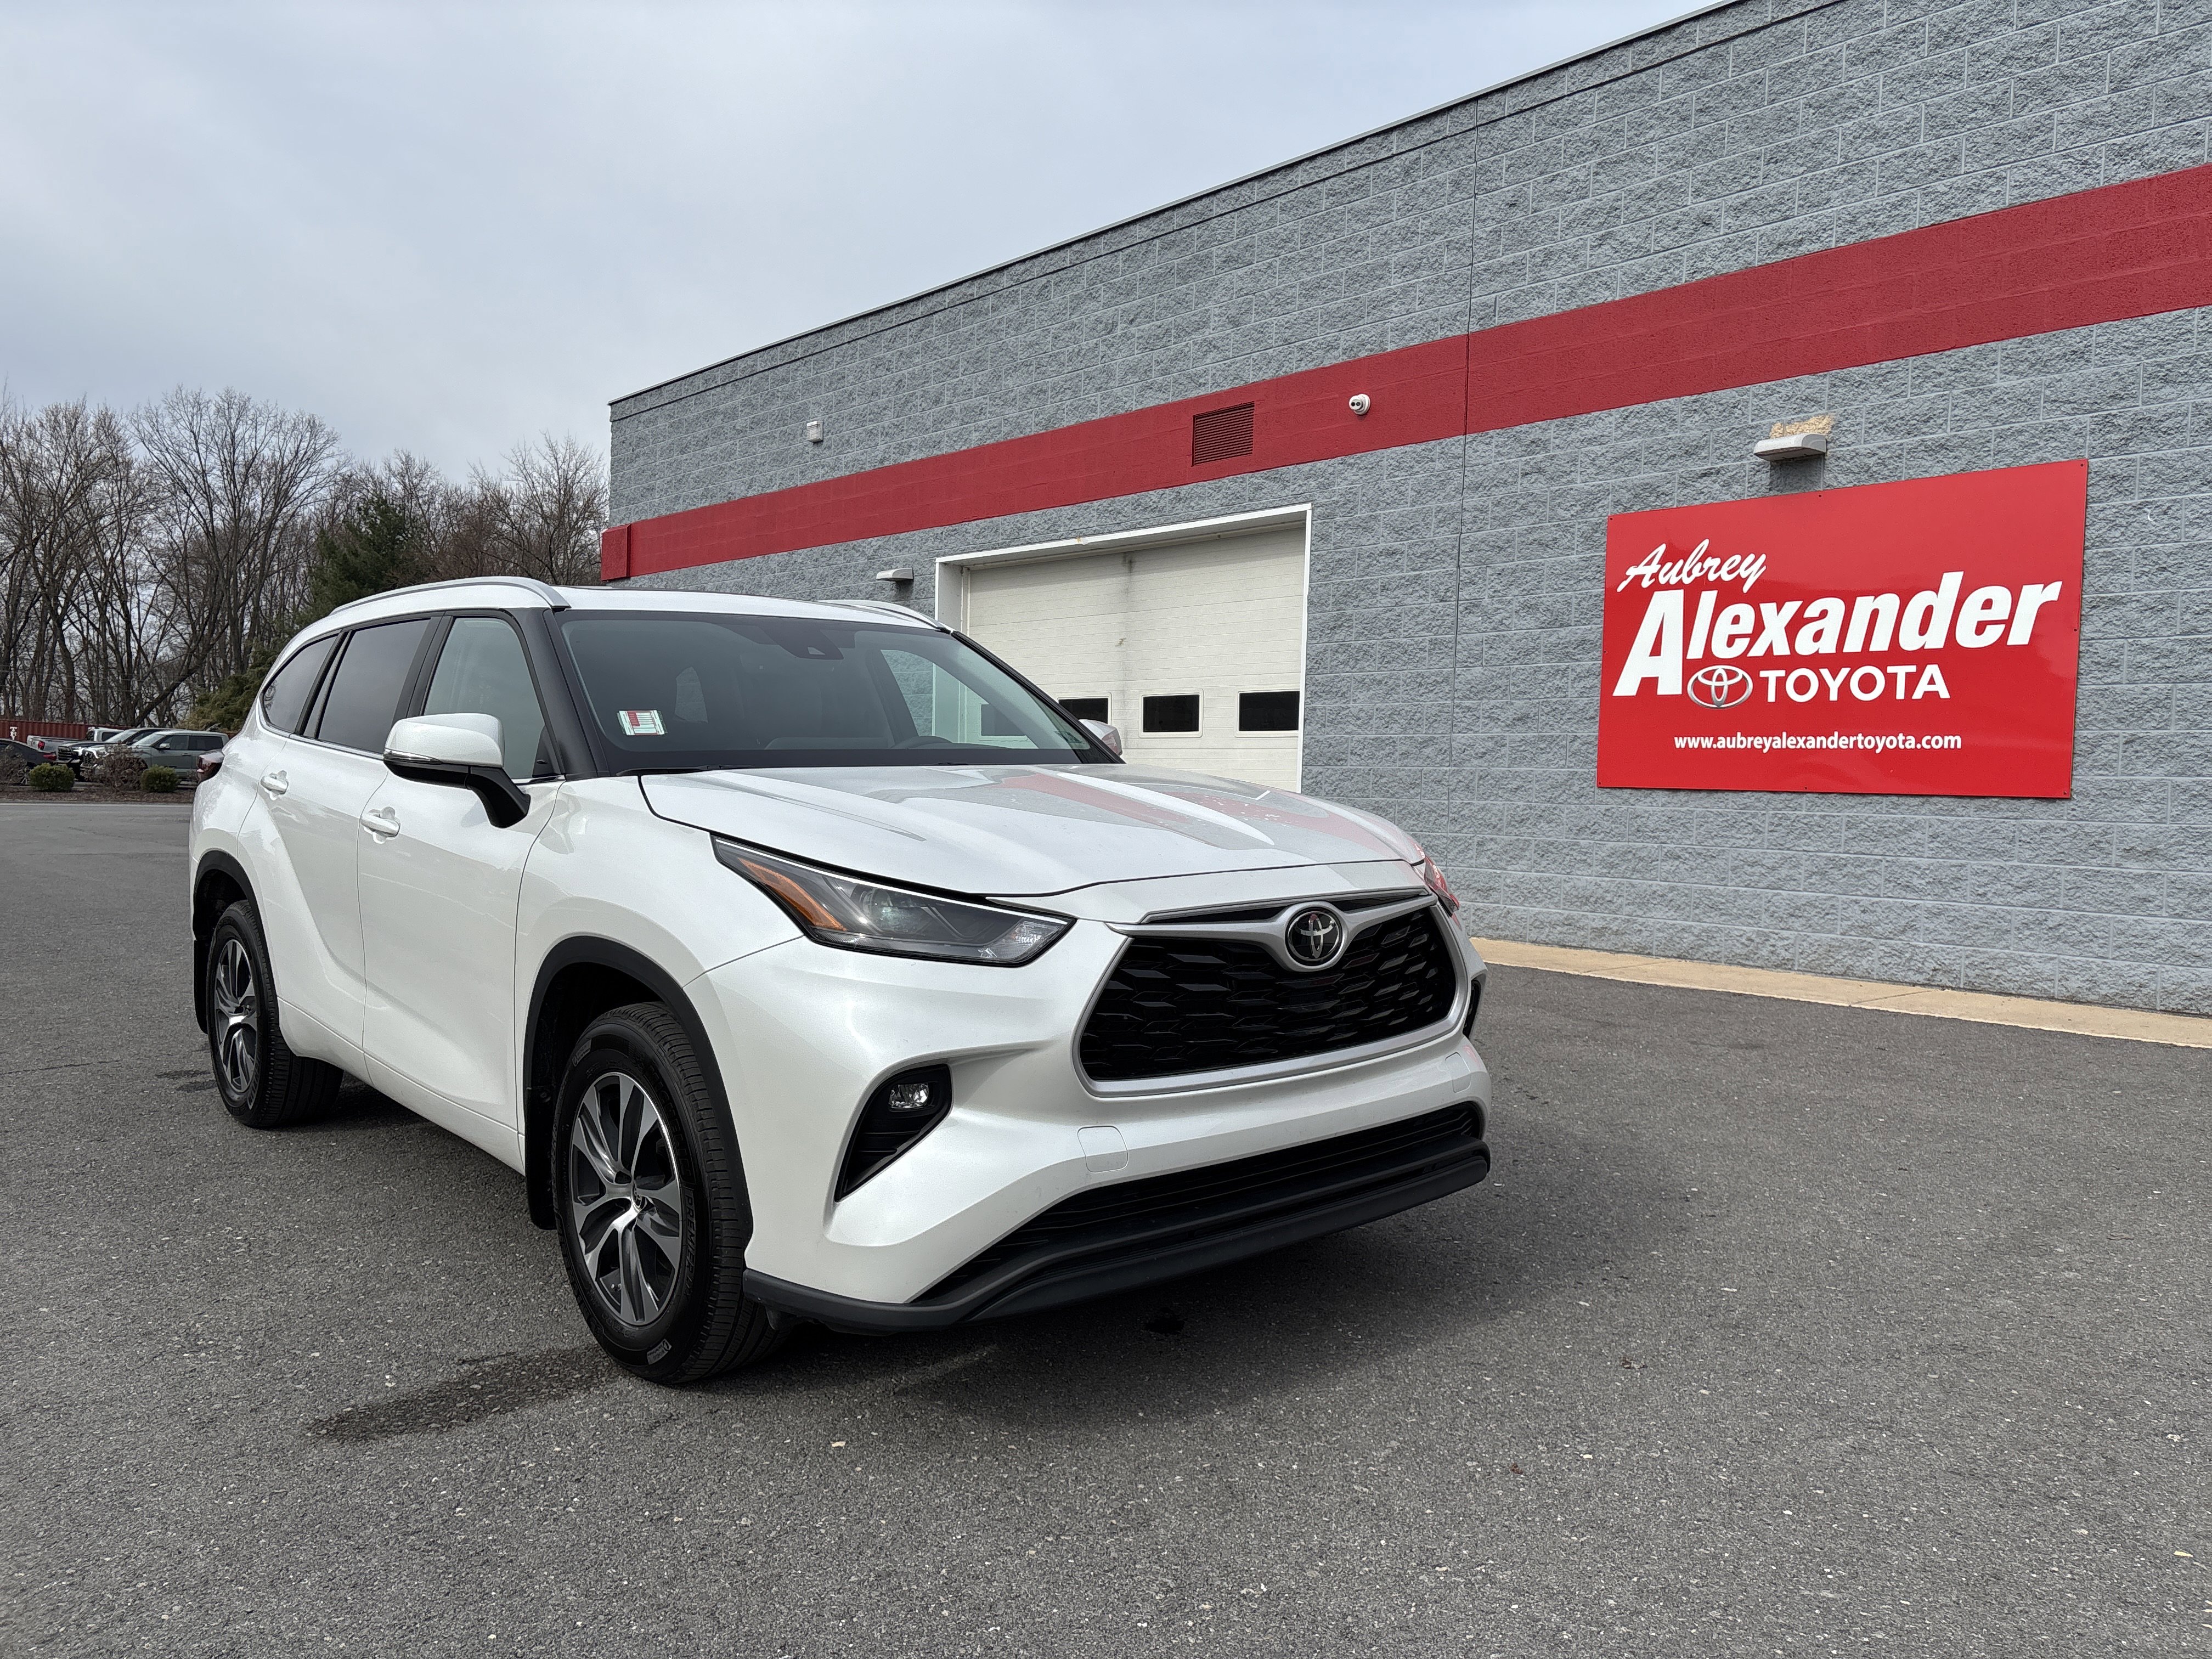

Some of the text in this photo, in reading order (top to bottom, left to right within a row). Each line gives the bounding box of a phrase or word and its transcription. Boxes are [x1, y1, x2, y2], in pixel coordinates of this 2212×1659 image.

[1617, 539, 1767, 594] Aubrey
[1612, 571, 2063, 697] Alexander
[1759, 664, 1951, 703] TOYOTA
[1674, 731, 1962, 754] www.aubreyalexandertoyota.com
[685, 1194, 696, 1273] PREMIER
